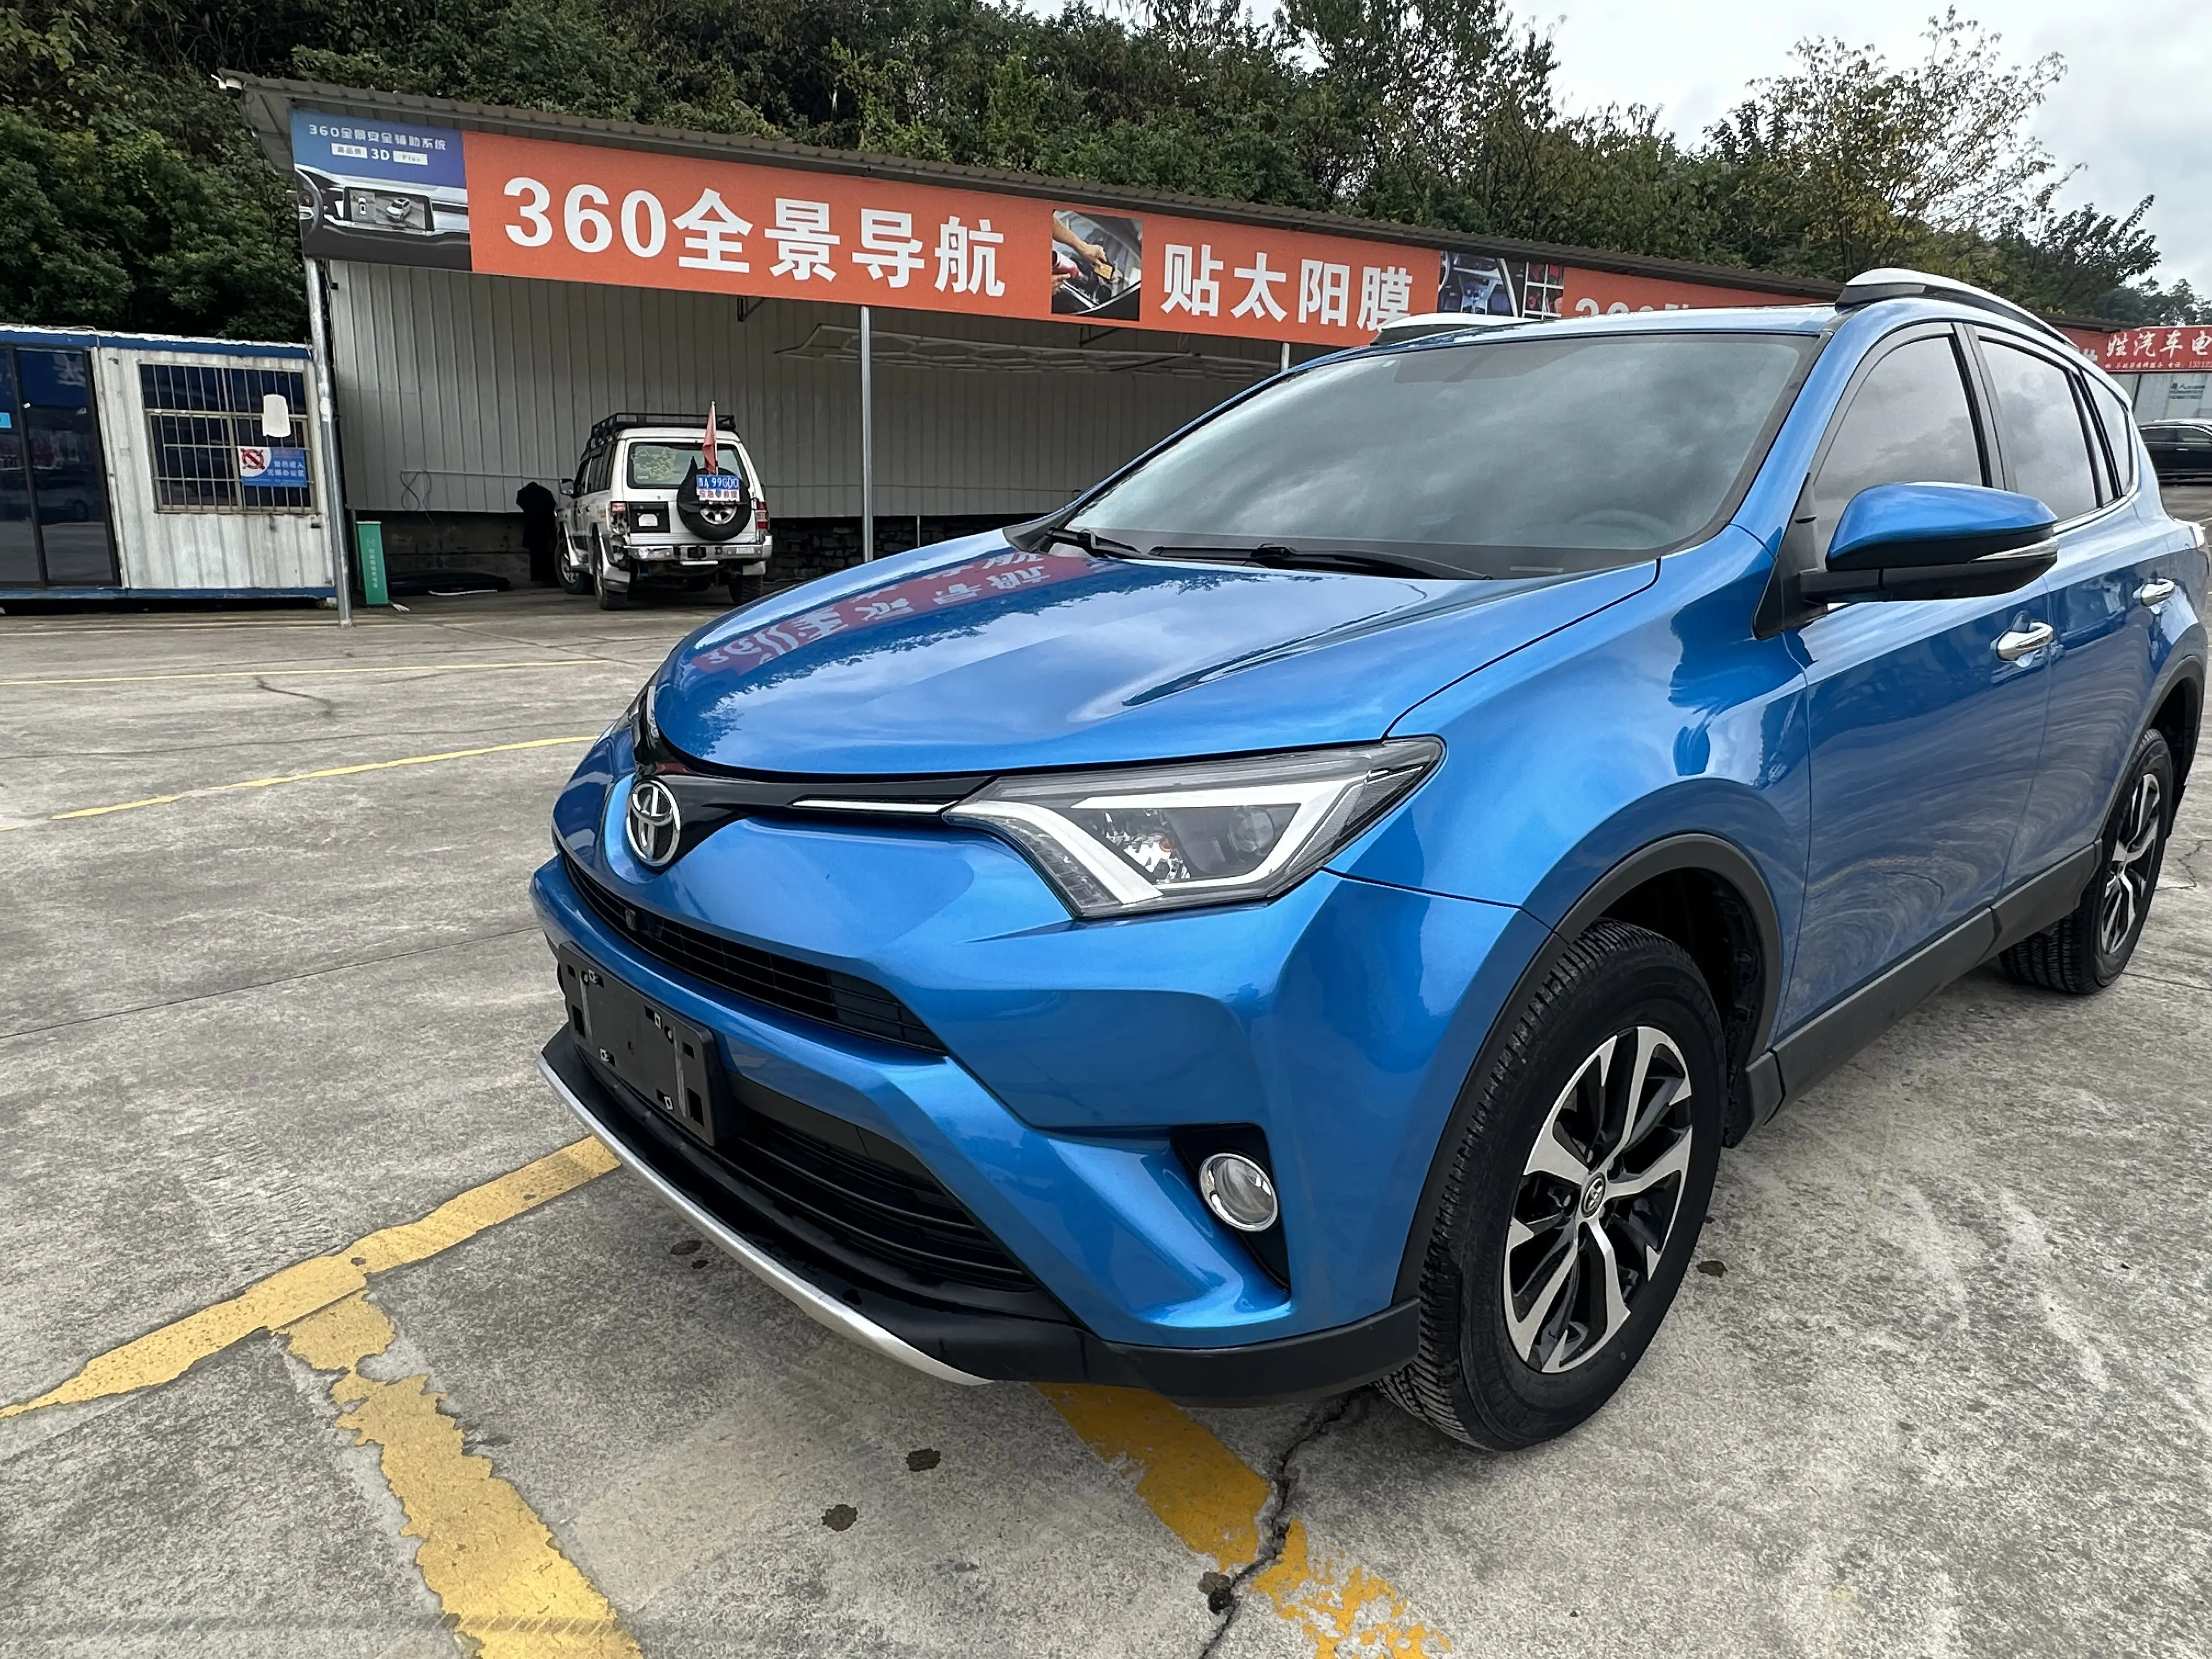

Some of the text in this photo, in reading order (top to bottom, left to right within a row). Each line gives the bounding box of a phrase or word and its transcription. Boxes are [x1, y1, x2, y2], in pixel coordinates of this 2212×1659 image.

[371, 148, 390, 160] 3D
[504, 176, 1006, 297] 360全景导航
[1160, 244, 1413, 332] 贴太阳膜
